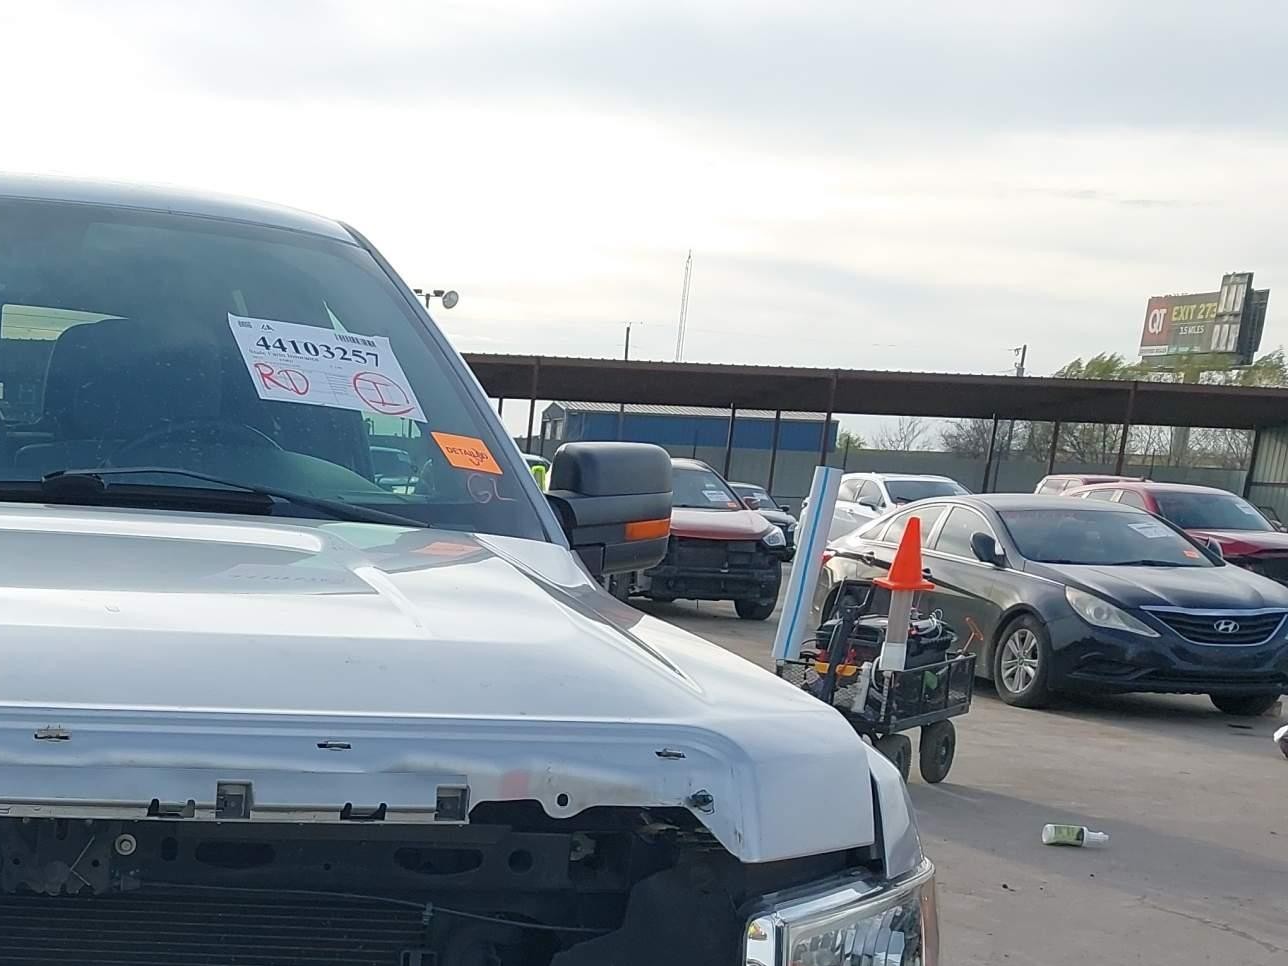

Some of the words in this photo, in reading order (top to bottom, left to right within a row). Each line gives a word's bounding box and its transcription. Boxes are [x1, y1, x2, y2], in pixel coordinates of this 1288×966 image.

[1148, 308, 1168, 335] QT
[1172, 304, 1197, 321] EXIT
[255, 335, 379, 368] 44103257
